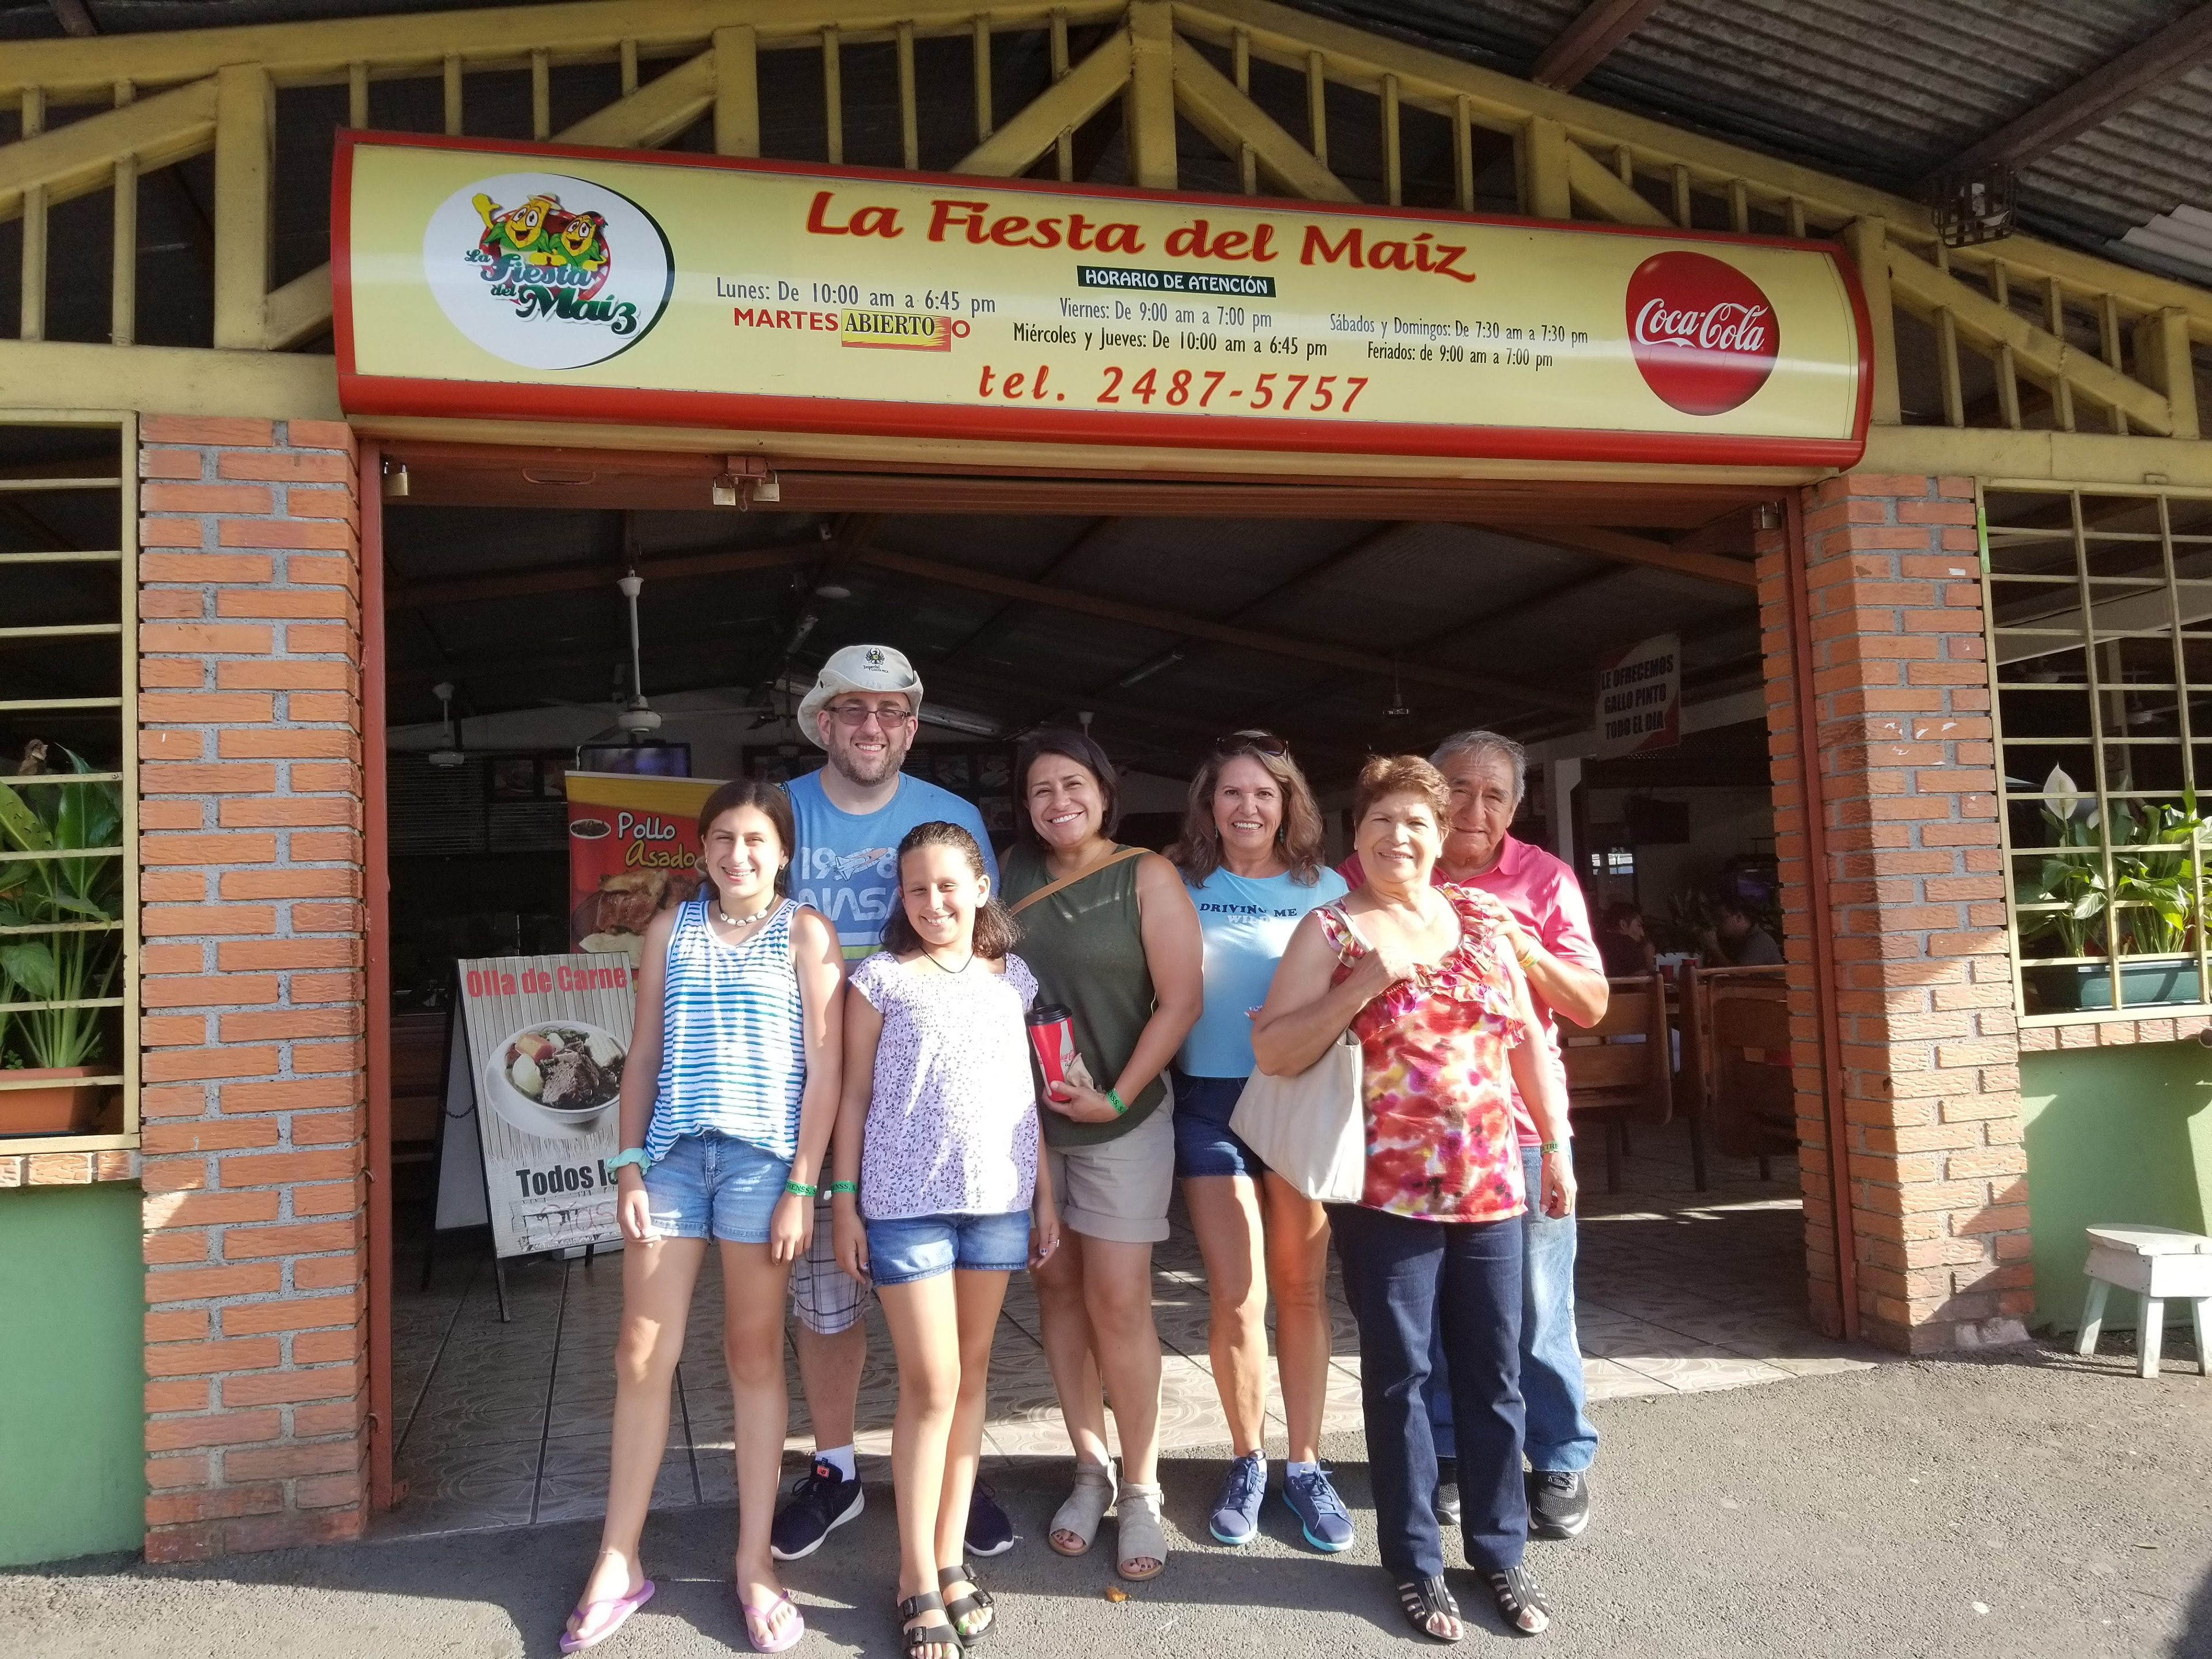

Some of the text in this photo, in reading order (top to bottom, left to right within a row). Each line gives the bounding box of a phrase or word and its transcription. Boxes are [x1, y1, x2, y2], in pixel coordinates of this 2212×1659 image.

[806, 191, 1476, 283] La Fiesta del Maíz
[465, 248, 492, 265] La
[491, 284, 517, 297] del
[717, 276, 996, 317] Lunes: De 10:00 am a 6:45 pm
[1085, 269, 1268, 294] HORARIO DE ATENCIÓN
[733, 308, 838, 331] MARTES
[845, 312, 935, 337] ABIERTO
[1059, 297, 1272, 333] Viernes: De 9:00 am a 7:00 pm
[1330, 312, 1589, 347] Sábados y Domingos: De 7:30 am a 7:30 pm
[1634, 297, 1769, 353] Coca-Cola
[1013, 322, 1327, 361] Miércoles y Jueves: De 10:00 am a 6:45 pm
[1367, 341, 1553, 370] Feriados: de 9:00 am a 7:00 pm
[979, 365, 1369, 413] tel. 2487-5757
[1601, 654, 1673, 690] LE OFRECEMOS
[1605, 683, 1666, 714] GALLO PINTO
[1605, 718, 1631, 740] TODO
[1633, 715, 1643, 734] EL
[617, 811, 676, 842] Pollo
[798, 887, 899, 921] NAS
[1274, 908, 1297, 918] ME
[467, 963, 628, 998] Olla de Carne
[516, 1165, 594, 1198] Todos
